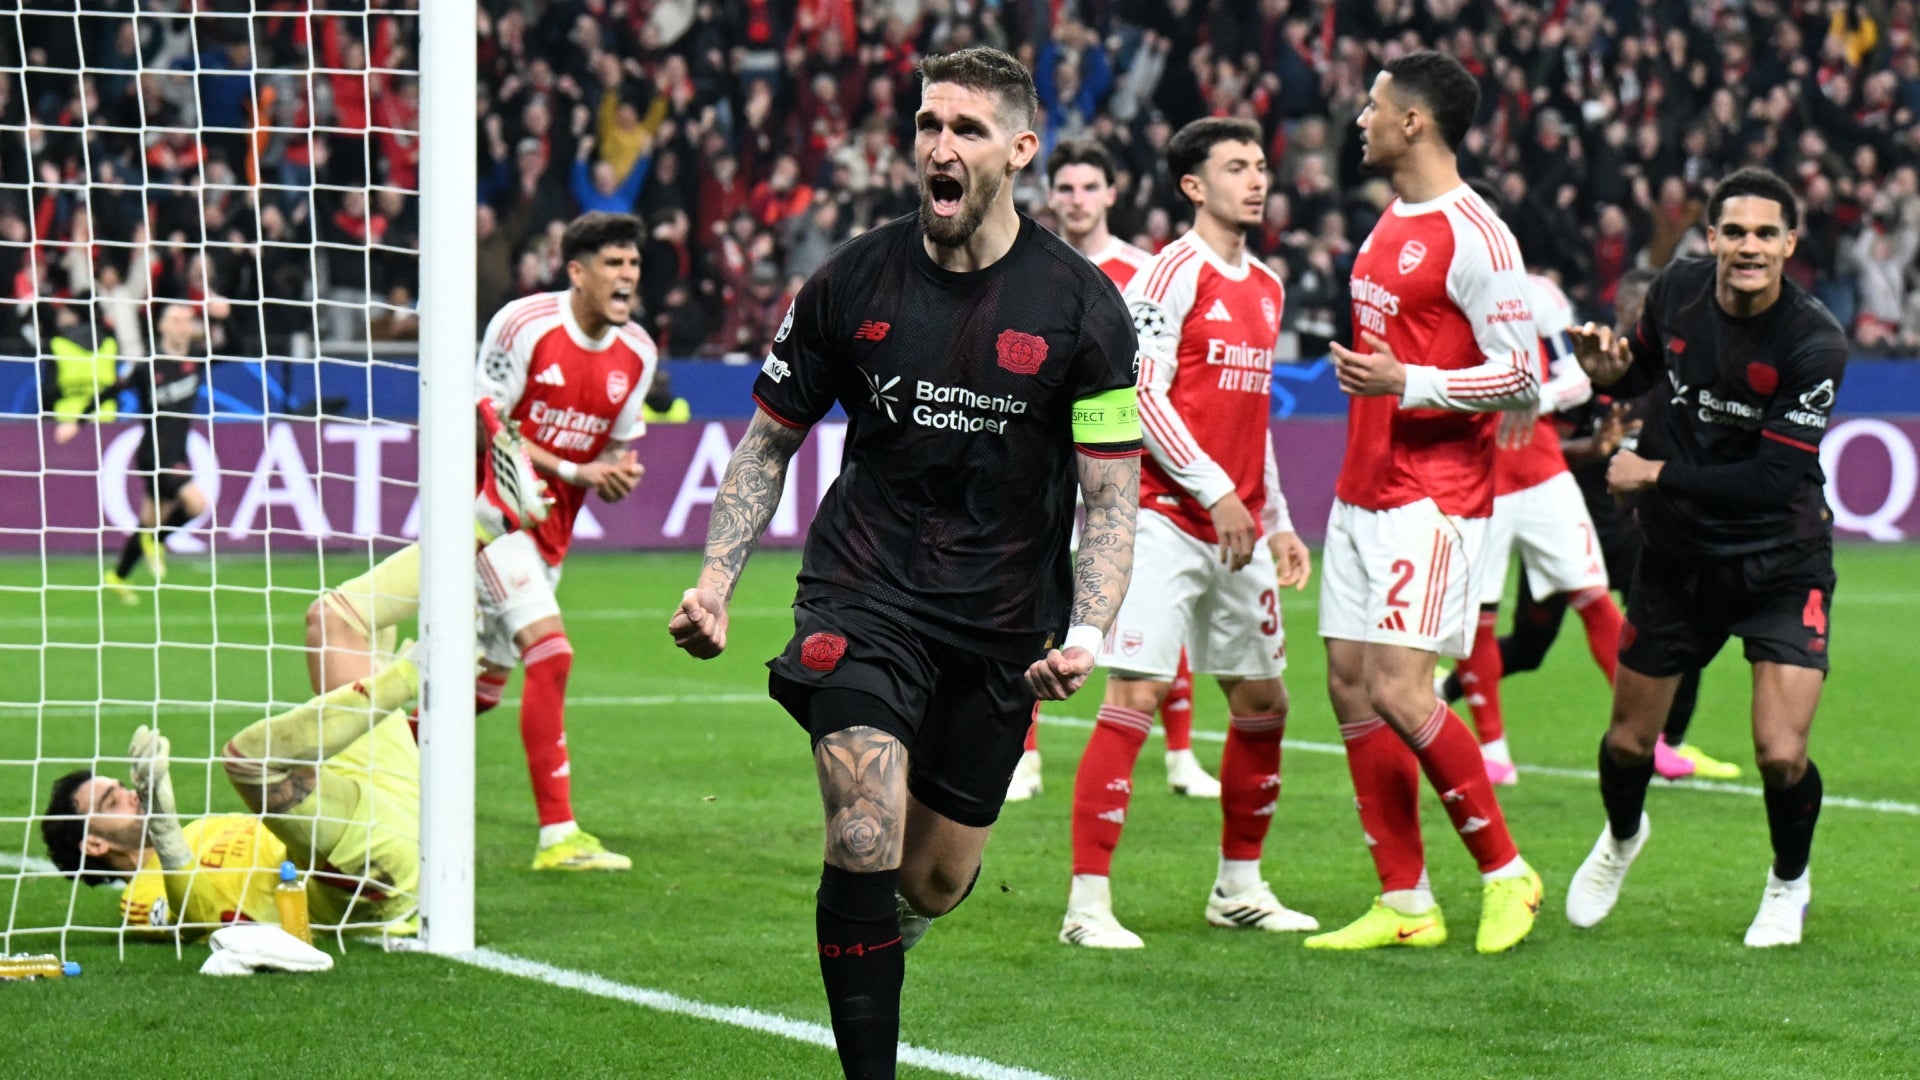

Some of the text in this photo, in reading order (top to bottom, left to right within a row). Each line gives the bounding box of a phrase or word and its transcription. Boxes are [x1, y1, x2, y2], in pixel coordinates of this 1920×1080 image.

[1349, 273, 1401, 317] mirates
[1496, 299, 1522, 311] VISIT
[1218, 368, 1241, 391] FLY
[916, 380, 1028, 414] Barmenia
[529, 400, 610, 435] Emirates
[912, 404, 1008, 435] Gothaer
[1578, 522, 1592, 556] 7
[1386, 559, 1416, 608] 2
[1259, 589, 1278, 636] 3
[1803, 588, 1827, 635] 4
